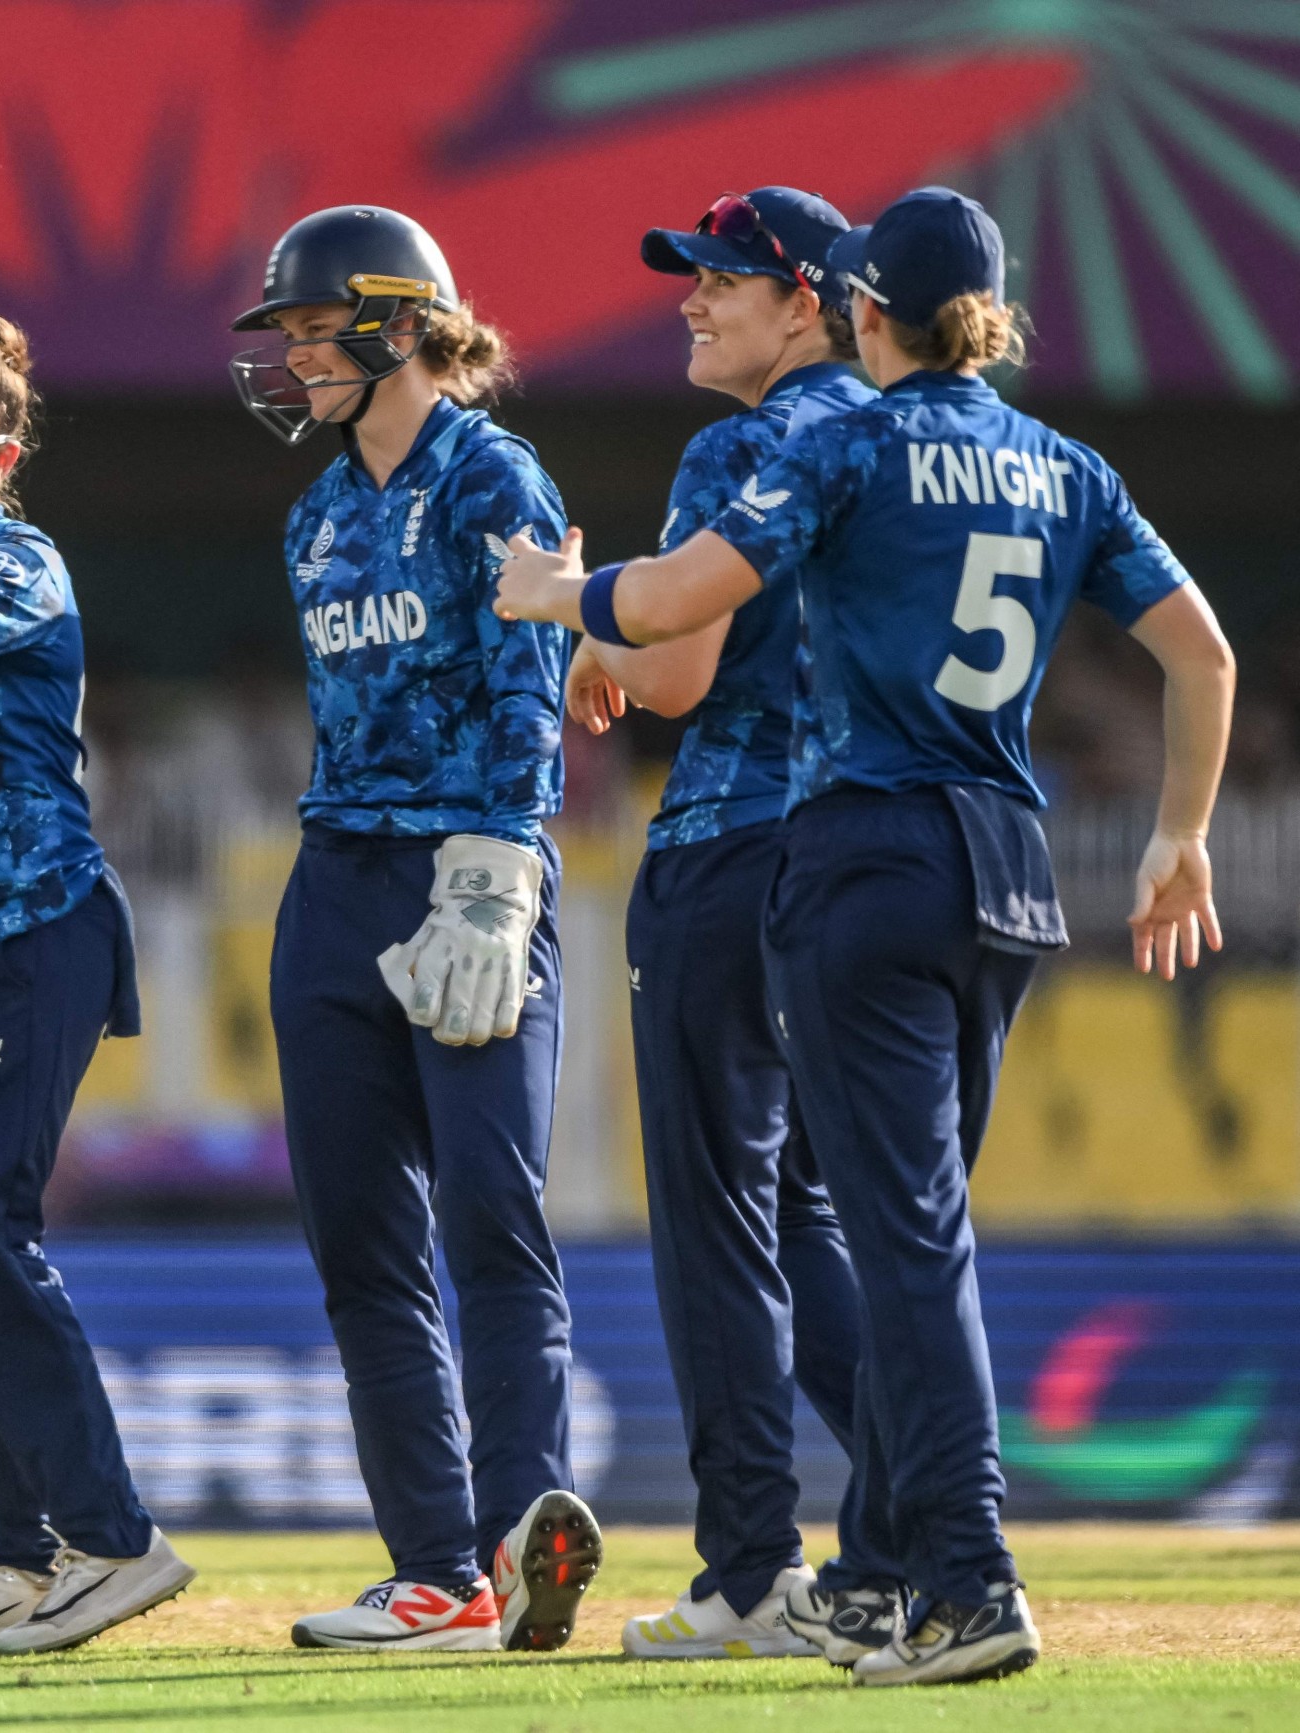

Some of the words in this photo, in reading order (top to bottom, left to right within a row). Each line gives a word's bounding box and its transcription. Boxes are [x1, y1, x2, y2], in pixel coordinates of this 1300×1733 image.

[799, 260, 825, 283] 118
[908, 443, 1071, 519] KNIGHT
[304, 589, 428, 659] ENGLAND
[933, 532, 1044, 712] 5
